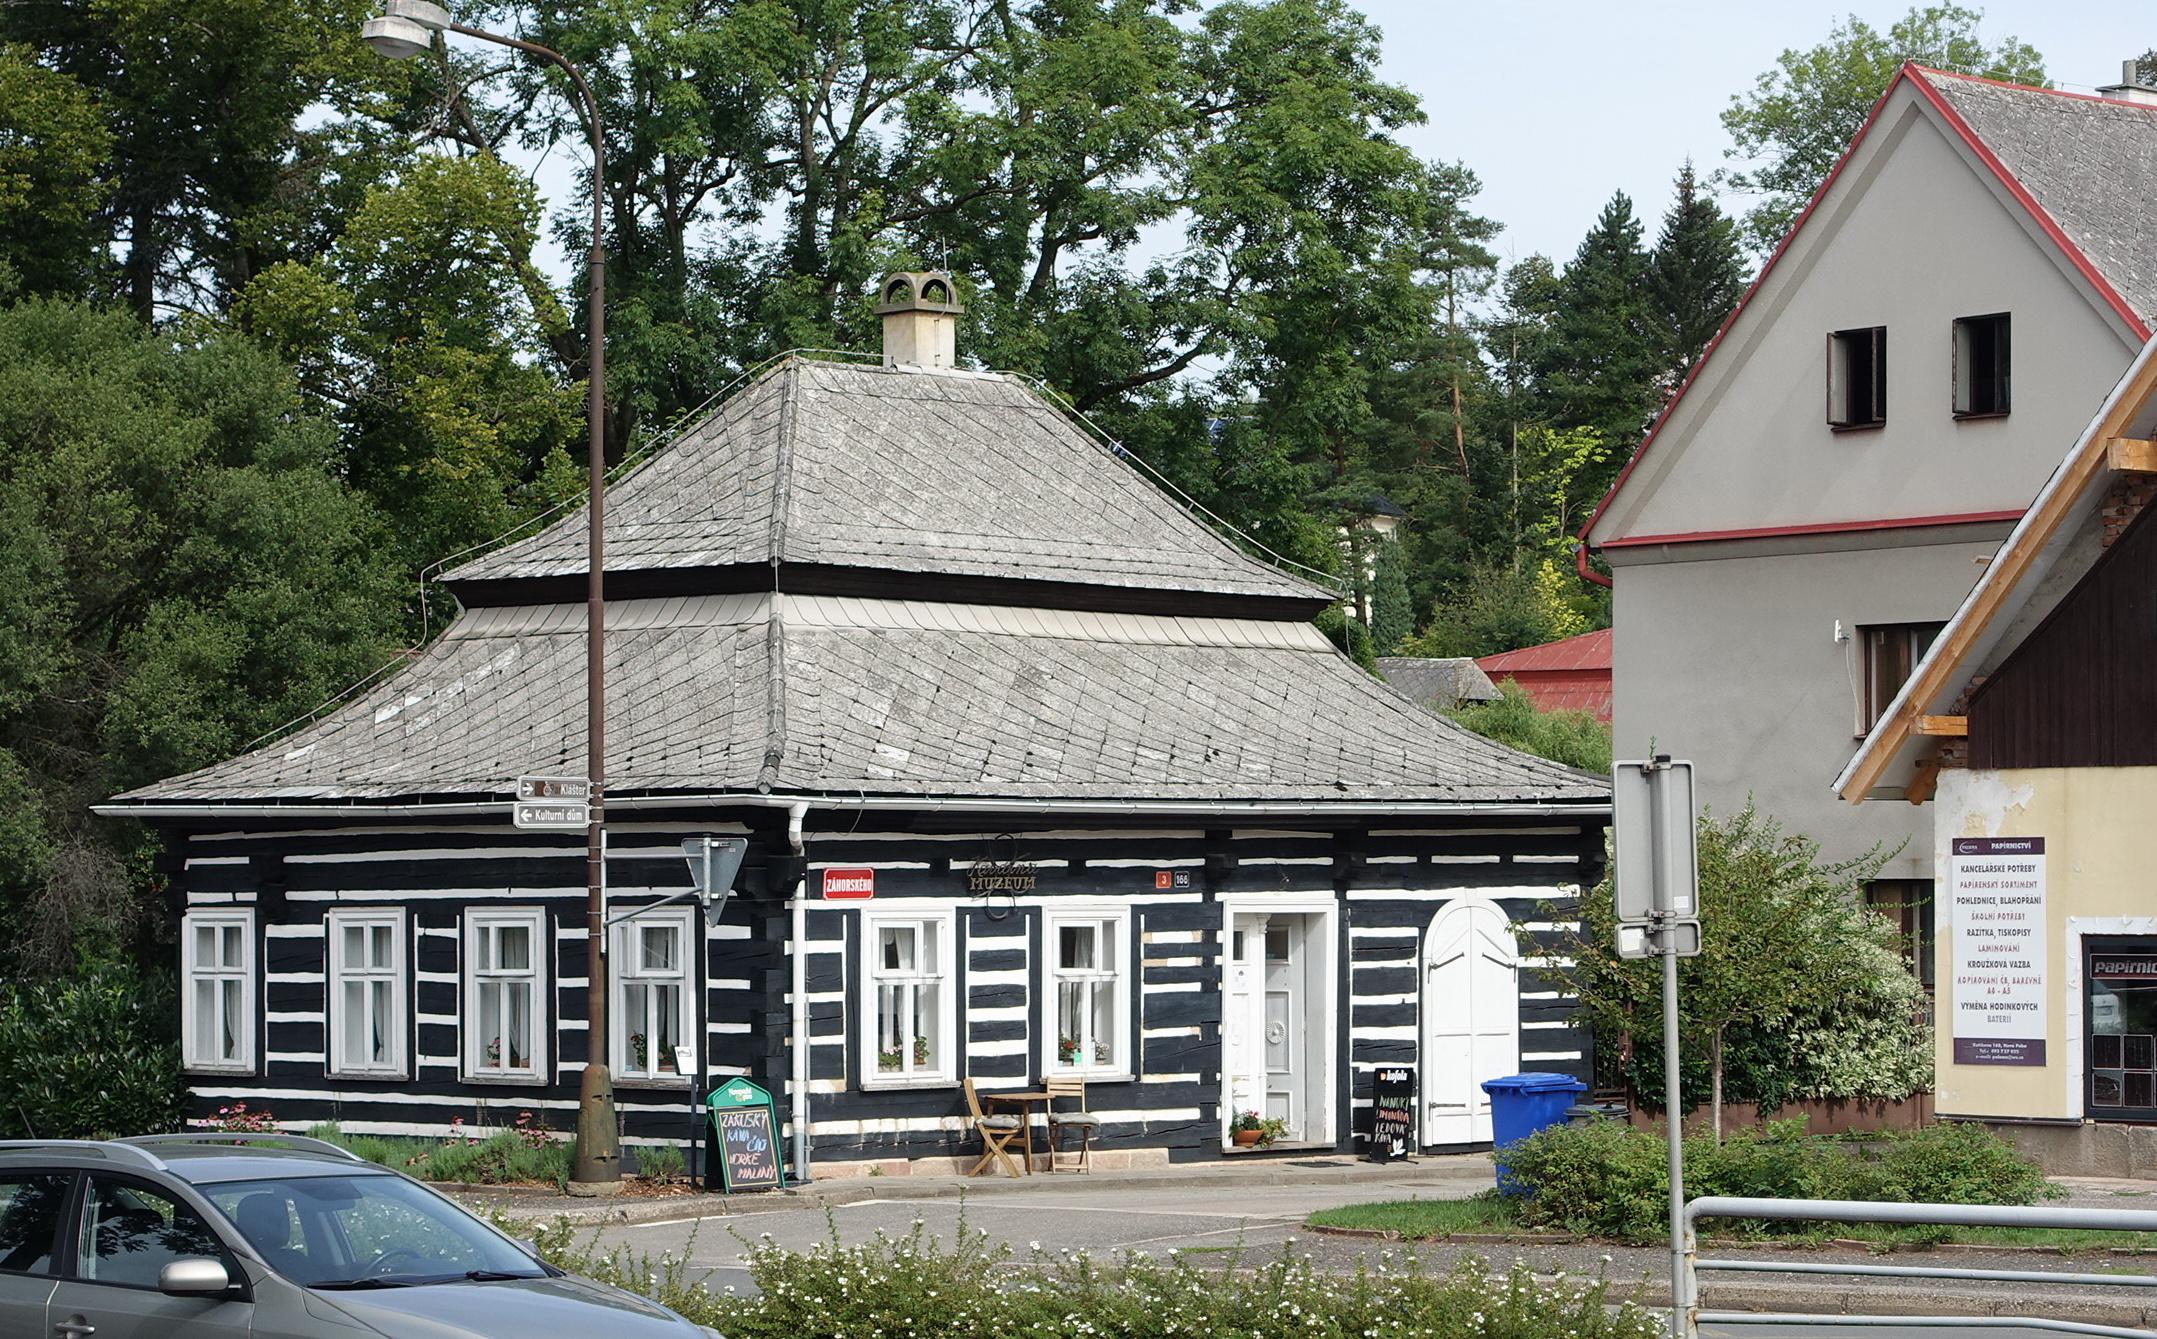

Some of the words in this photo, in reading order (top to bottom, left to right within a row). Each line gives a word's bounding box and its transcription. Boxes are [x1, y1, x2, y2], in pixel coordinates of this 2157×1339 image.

[560, 783, 587, 795] Klášter
[535, 808, 565, 821] Kulturní
[566, 808, 584, 821] dům
[1991, 841, 2032, 850] PAPÍRNICTVÍ
[2007, 862, 2036, 873] POTŘEBY
[826, 876, 871, 893] ZÁHORSKÉHO
[969, 876, 1037, 890] MUZEUM
[1161, 875, 1167, 885] 3
[1176, 874, 1188, 885] 166
[2000, 880, 2038, 889] SORTIMENT
[1956, 896, 1998, 907] POHLEDNICE,
[1998, 928, 2031, 937] TISKOPISY
[2009, 960, 2032, 969] VAZBA
[1386, 1069, 1409, 1084] kofola
[737, 1163, 777, 1180] MALINY
